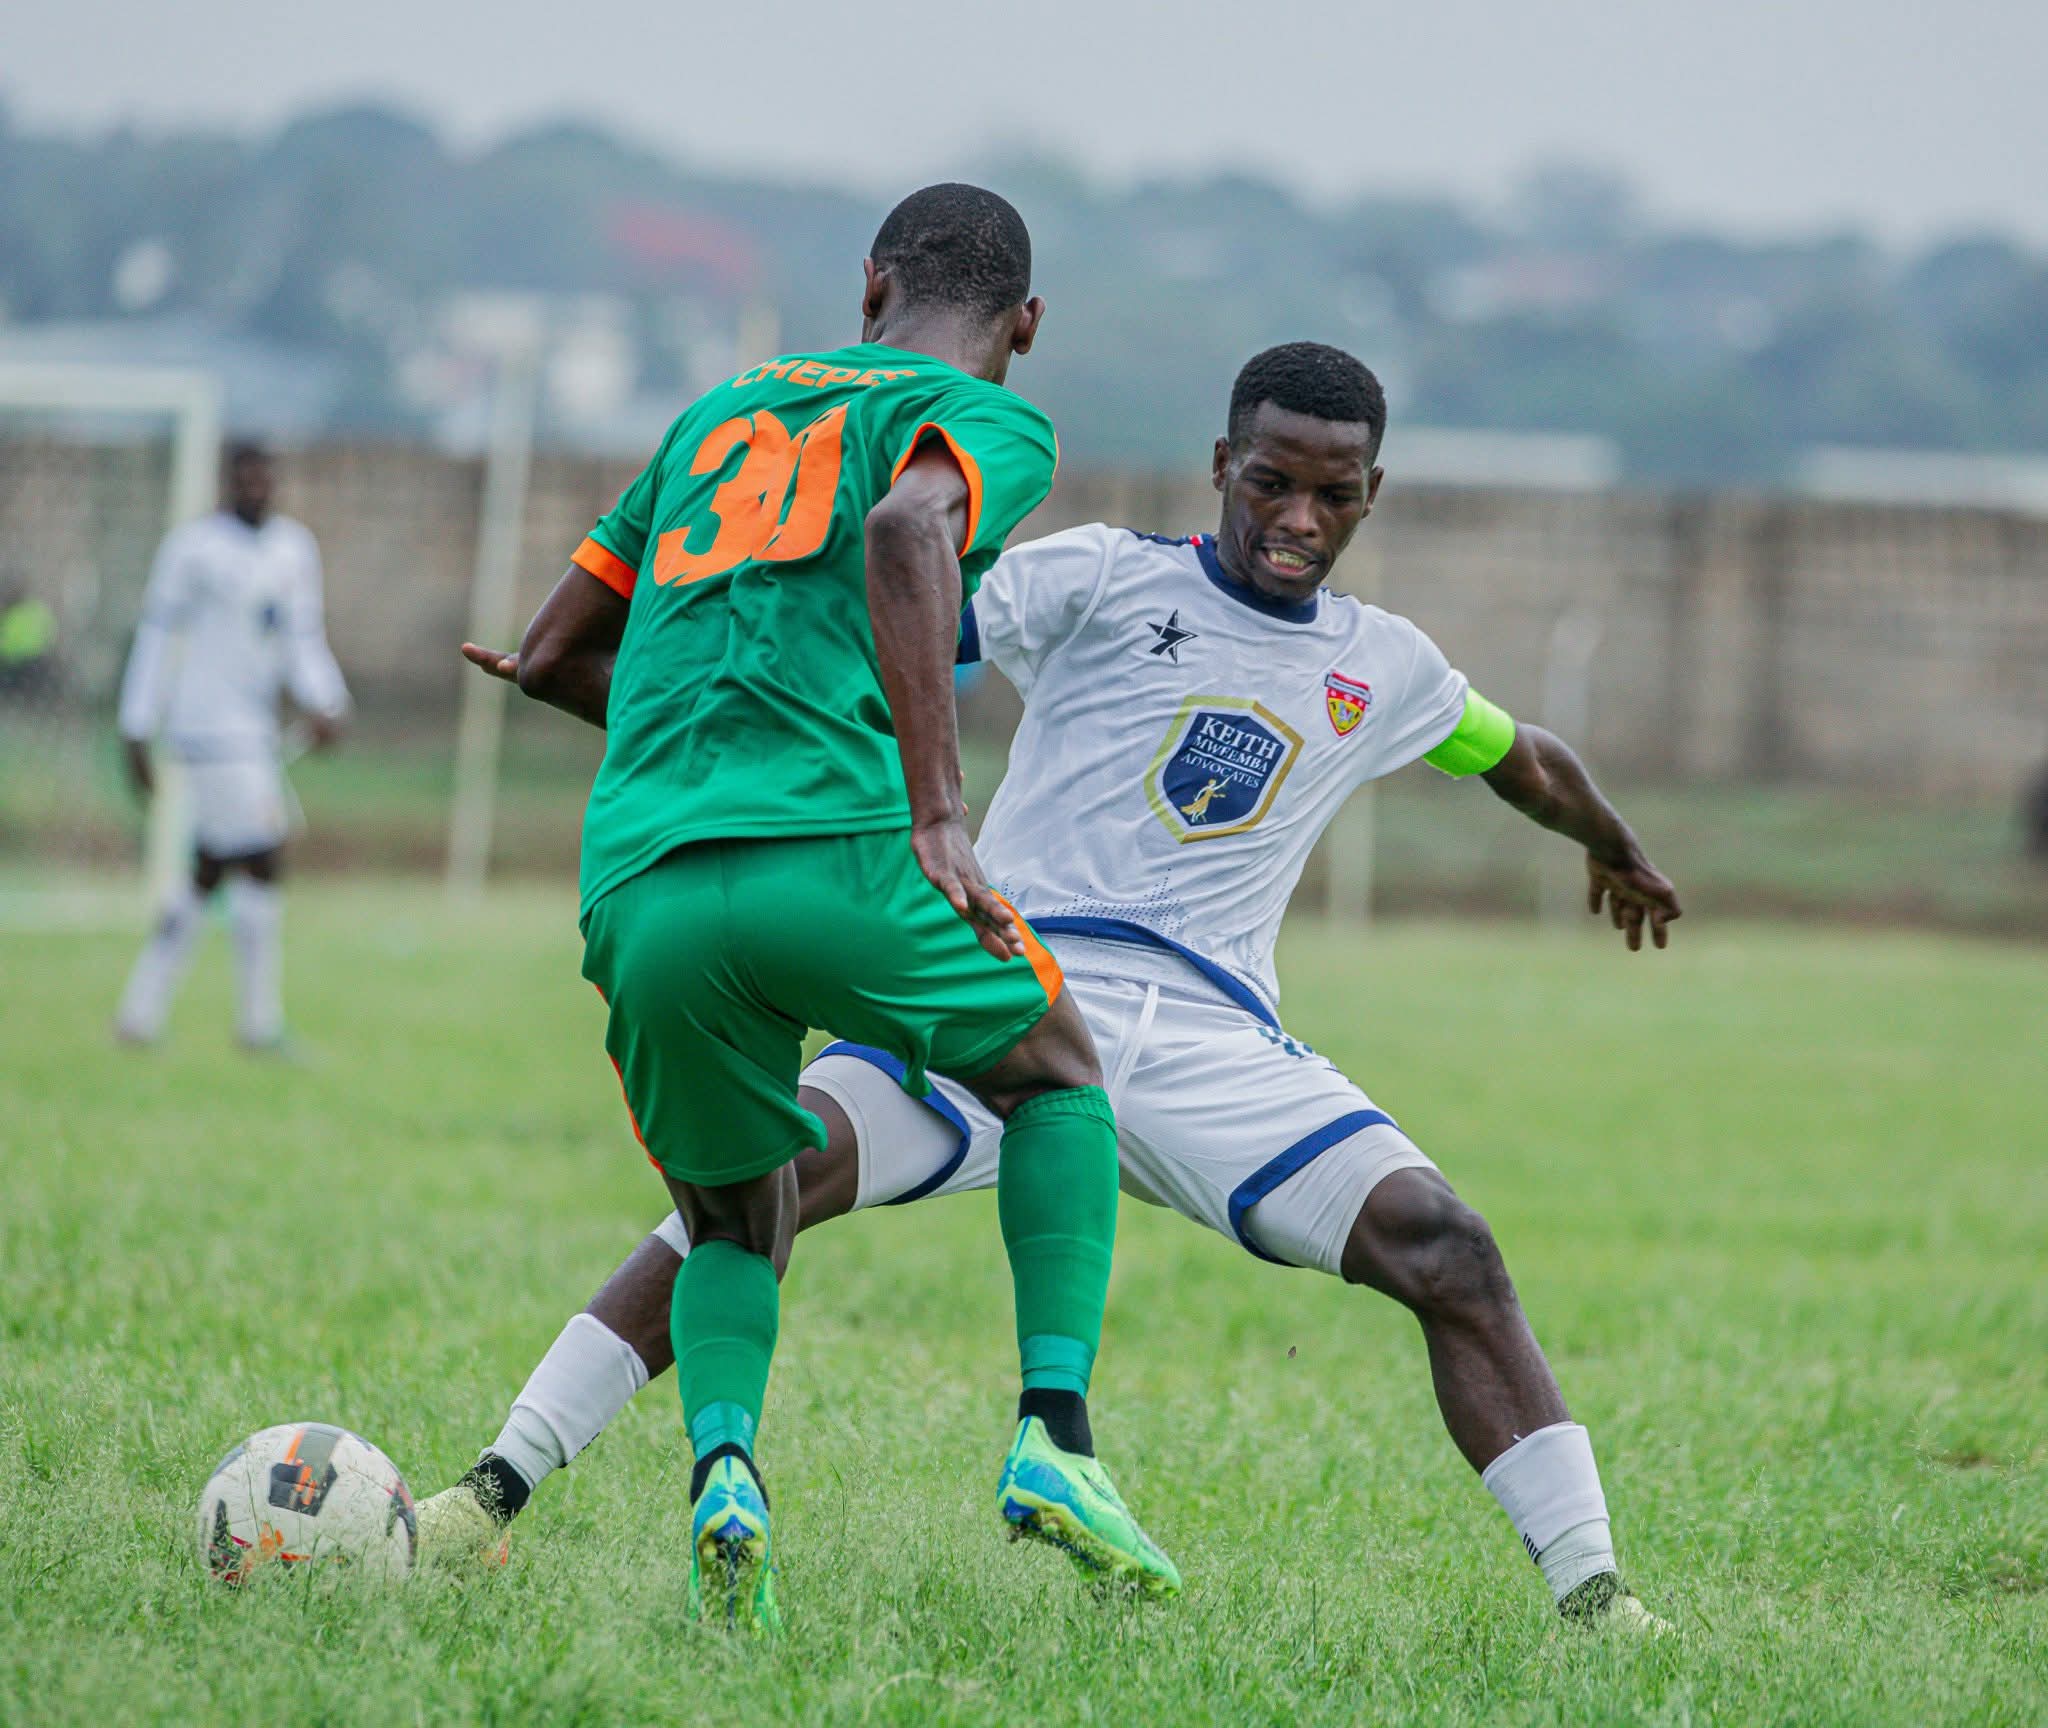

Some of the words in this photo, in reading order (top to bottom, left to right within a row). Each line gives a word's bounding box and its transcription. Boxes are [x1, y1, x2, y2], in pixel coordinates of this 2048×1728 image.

[653, 401, 850, 587] 30
[1193, 735, 1268, 773] MWEEMBA
[1200, 716, 1279, 759] KEITH
[1181, 753, 1260, 788] ADVOCATES
